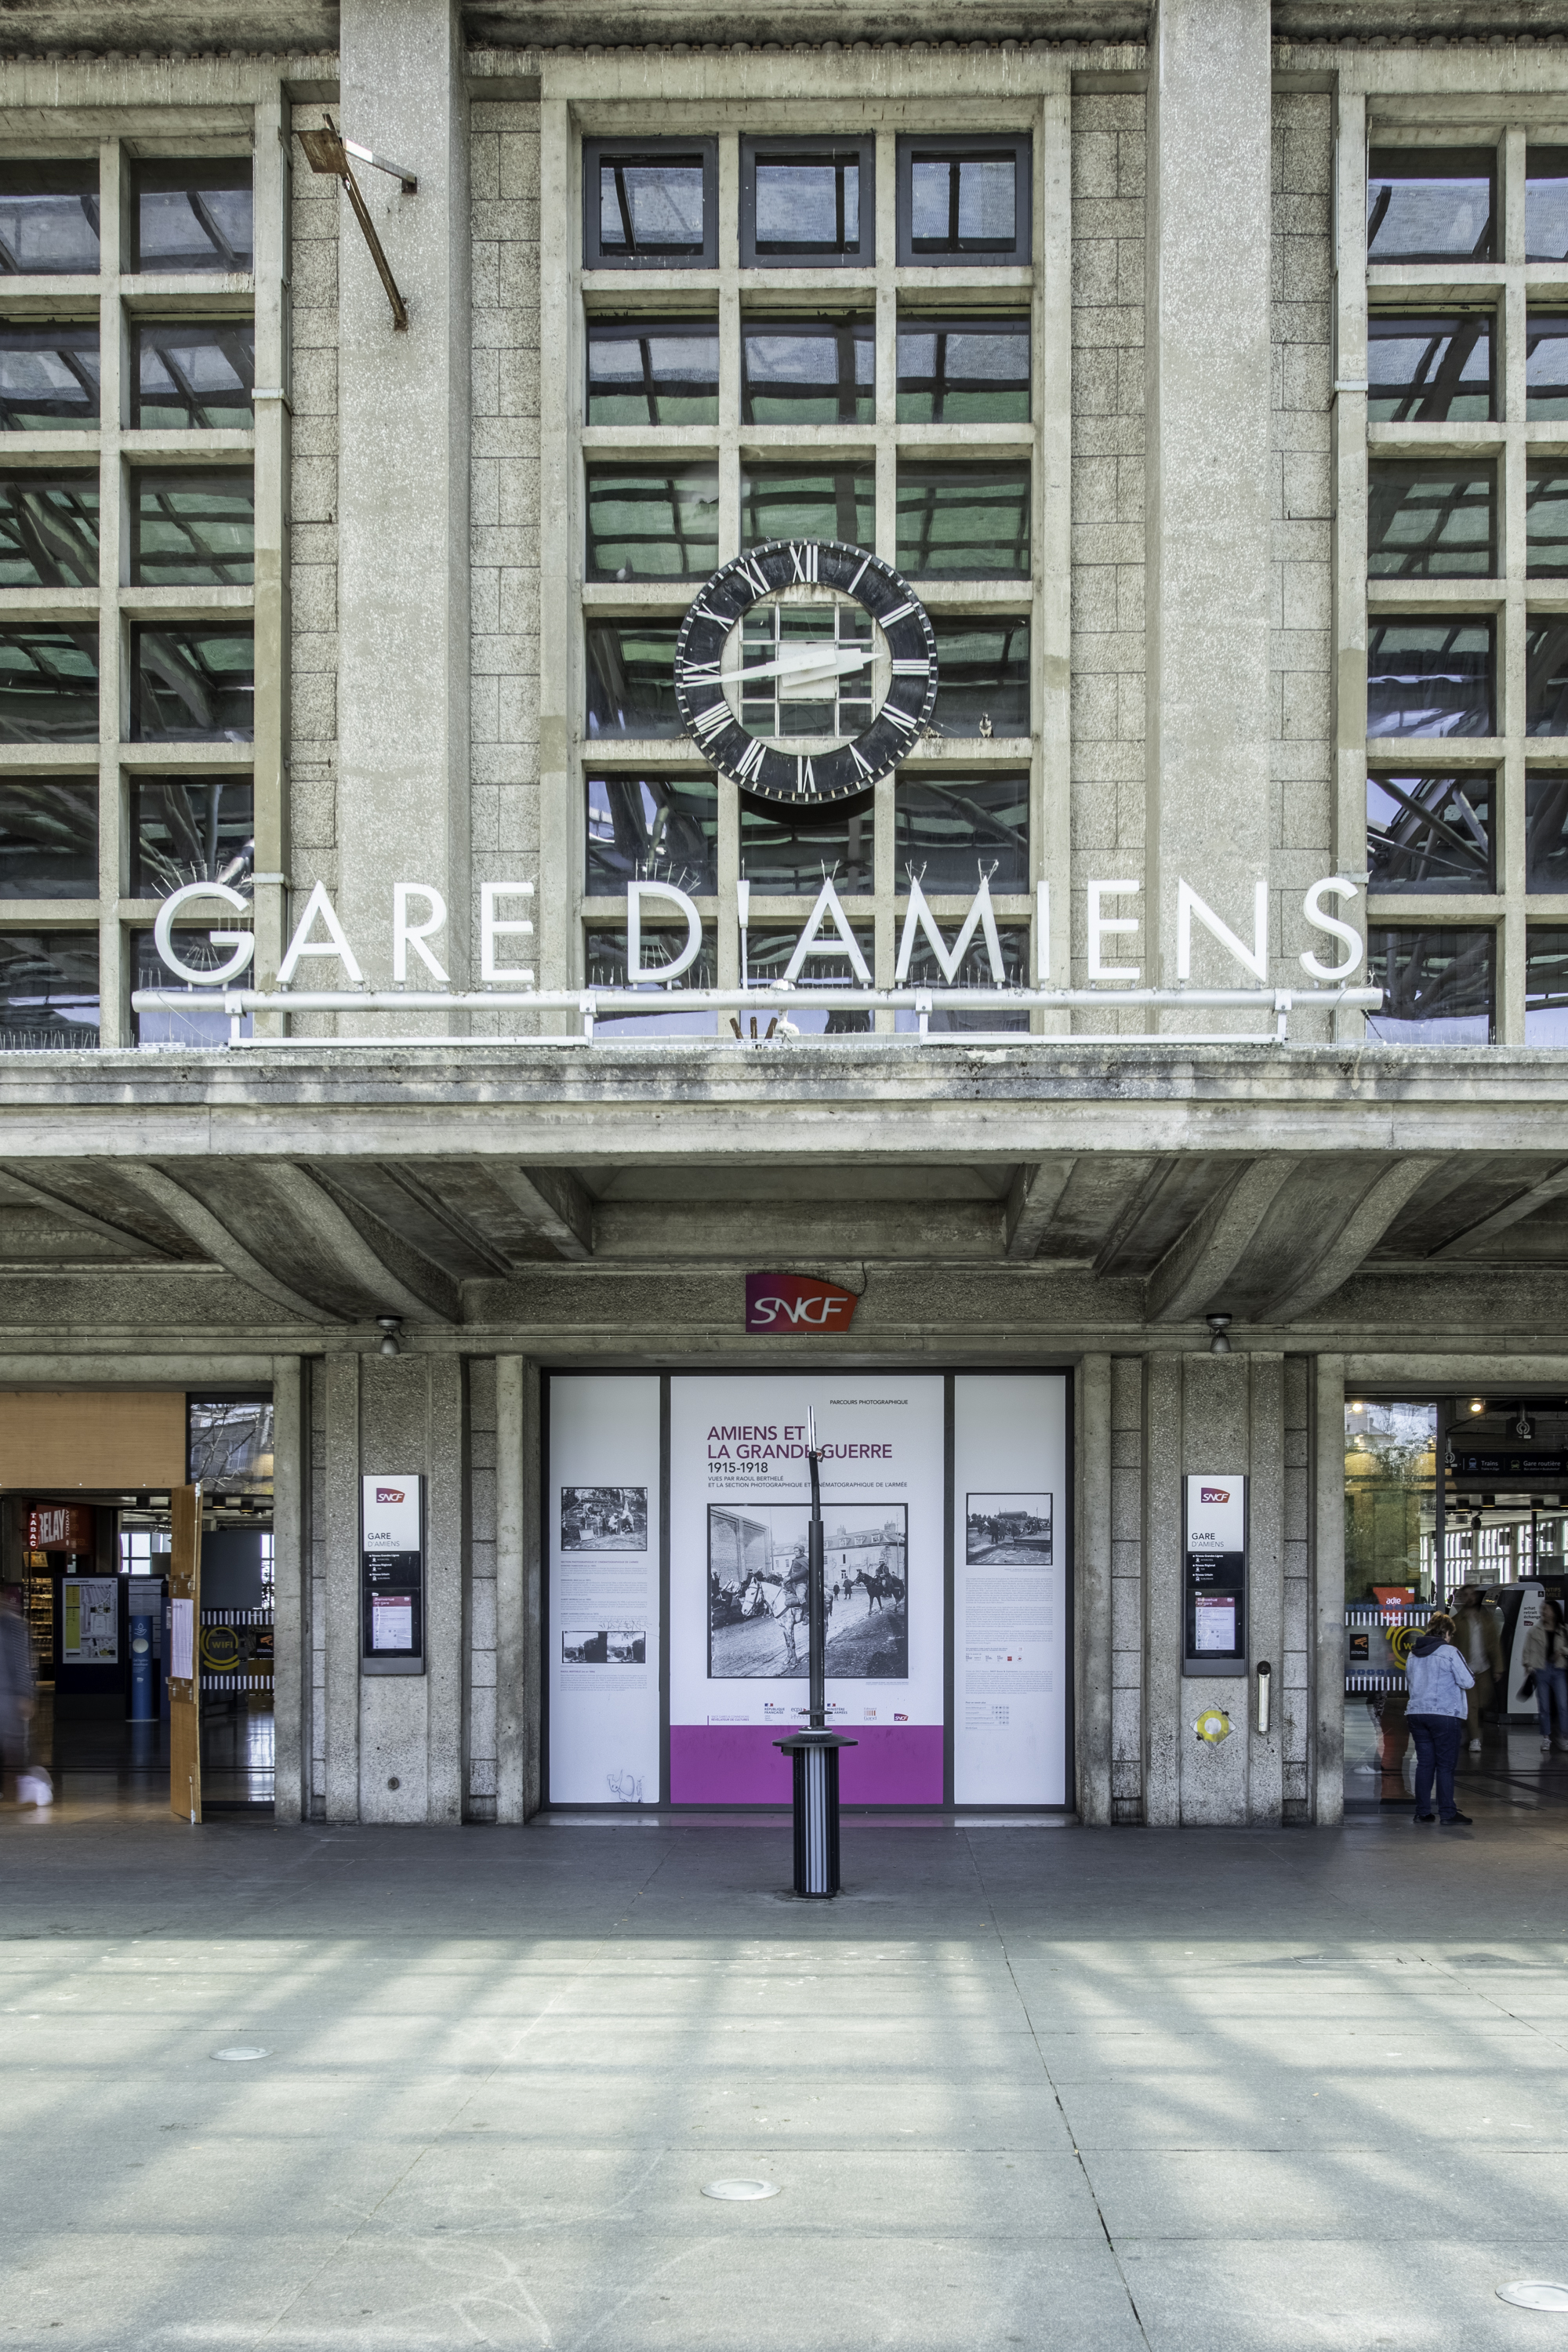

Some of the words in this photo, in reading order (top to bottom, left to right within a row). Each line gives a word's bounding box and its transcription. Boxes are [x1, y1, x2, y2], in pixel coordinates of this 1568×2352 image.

[154, 880, 535, 986] GARE
[750, 1297, 849, 1324] SNCF
[707, 1425, 778, 1441] AMIENS
[784, 1425, 805, 1440] ET
[708, 1444, 731, 1458] LA
[821, 1443, 893, 1459] GUERRE
[707, 1462, 768, 1473] 1915-1918
[38, 1508, 65, 1545] RELAY
